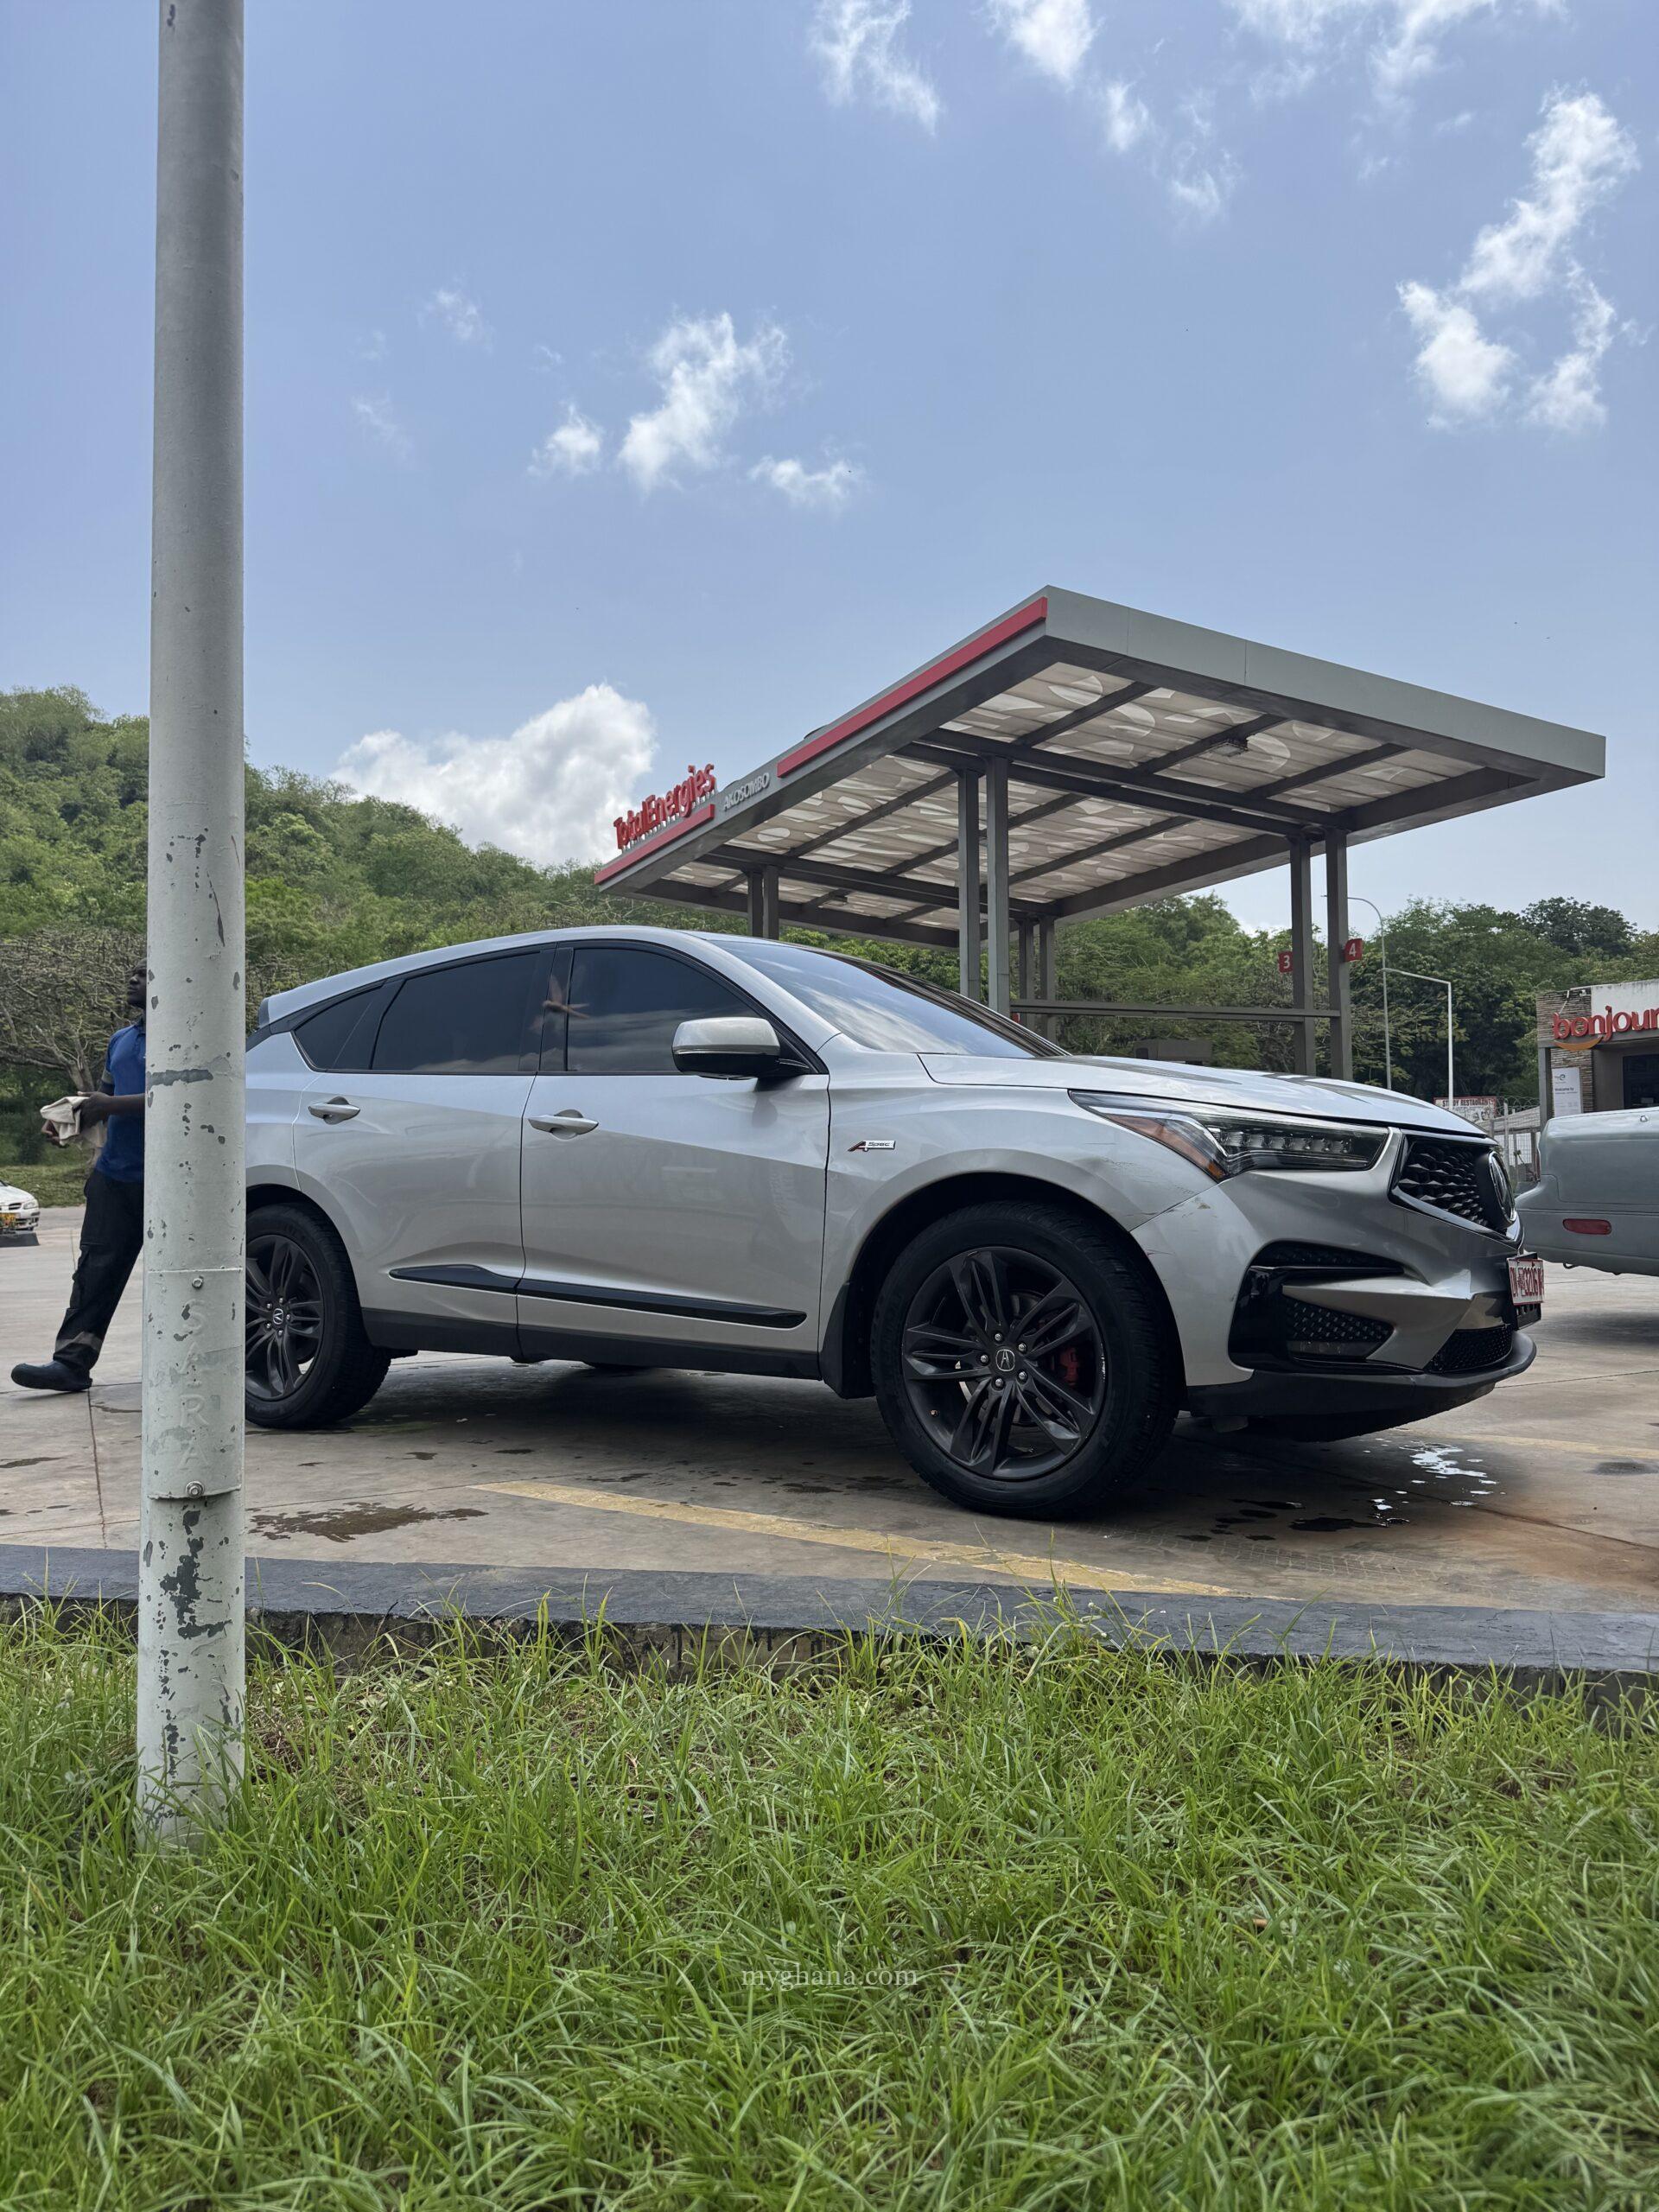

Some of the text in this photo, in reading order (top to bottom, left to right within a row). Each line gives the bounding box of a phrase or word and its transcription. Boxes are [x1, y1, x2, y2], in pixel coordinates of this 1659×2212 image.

[723, 772, 770, 810] AKOSOMBO
[613, 764, 715, 849] TotalEnergies
[1283, 955, 1290, 969] 3
[1349, 943, 1357, 957] 4
